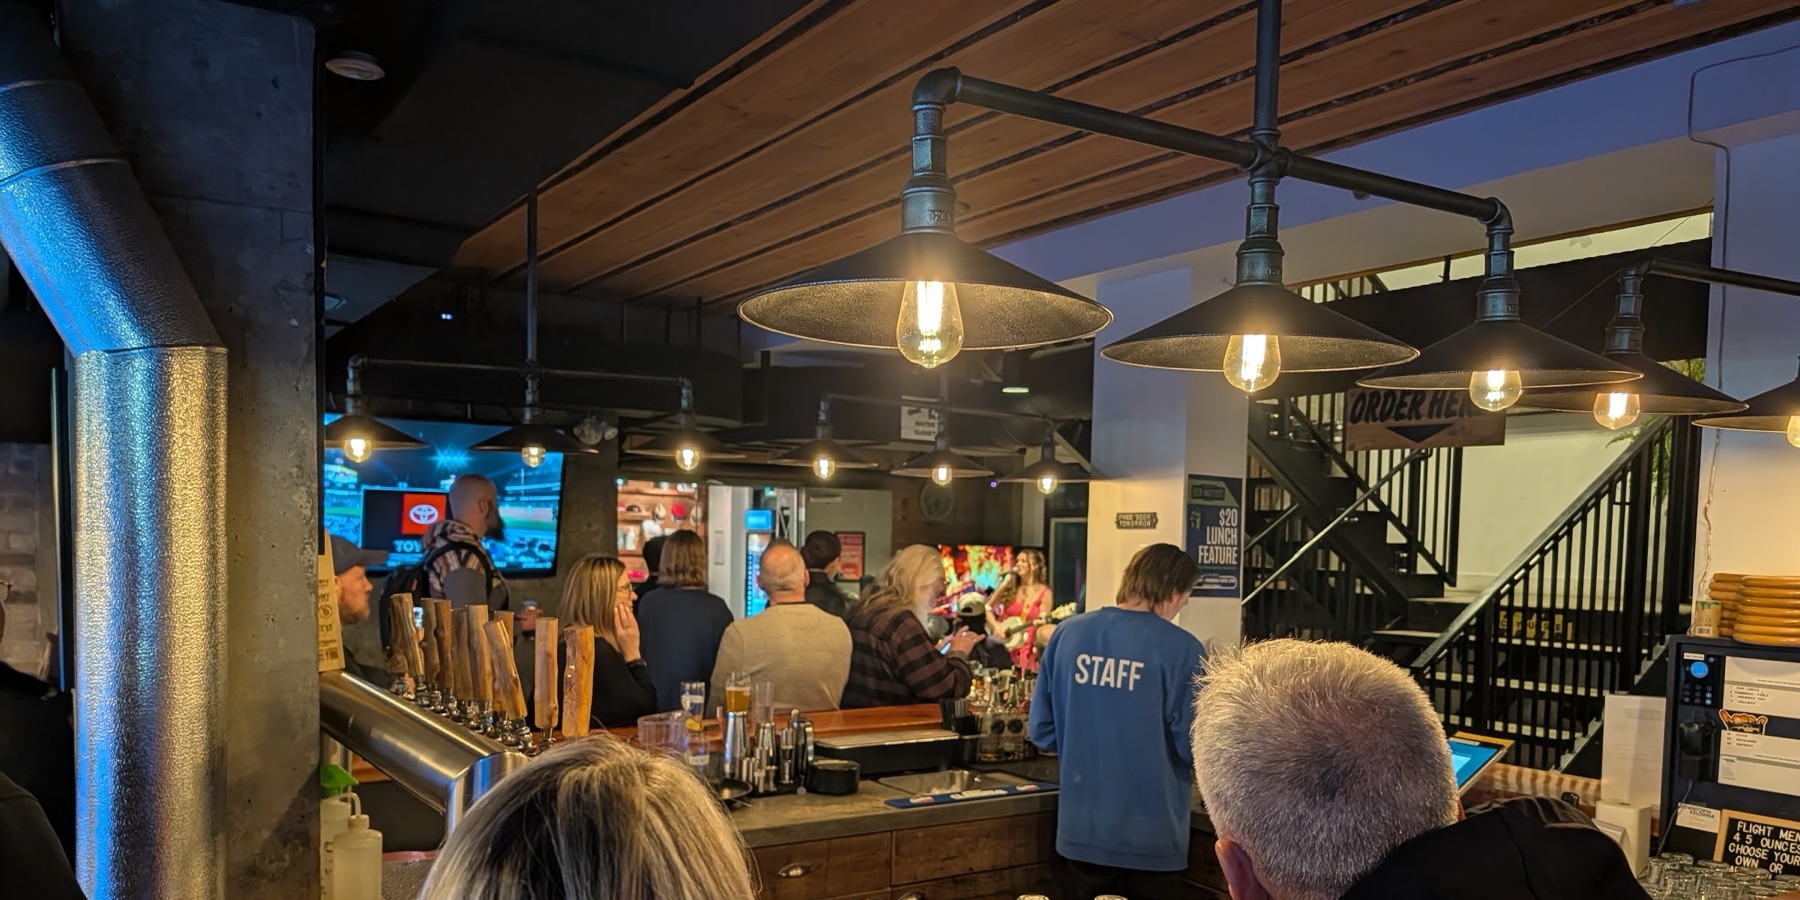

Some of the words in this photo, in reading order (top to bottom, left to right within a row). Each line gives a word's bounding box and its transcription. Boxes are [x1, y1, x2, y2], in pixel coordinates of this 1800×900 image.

[1350, 390, 1426, 424] ORDER
[1427, 390, 1481, 420] HER
[1219, 508, 1238, 526] $20
[1206, 526, 1238, 545] LUNCH
[1198, 545, 1238, 565] FEATURE
[1075, 653, 1144, 691] STAFF
[1689, 810, 1715, 819] KELOWNA
[1737, 821, 1774, 837] FLIGHT
[1733, 832, 1741, 842] 4
[1745, 835, 1753, 845] 5
[1760, 838, 1800, 854] OUNCES
[1728, 842, 1769, 860] CHOOSE
[1773, 851, 1800, 867] YOUR
[1735, 856, 1760, 868] OWN
[1769, 862, 1783, 874] OR
